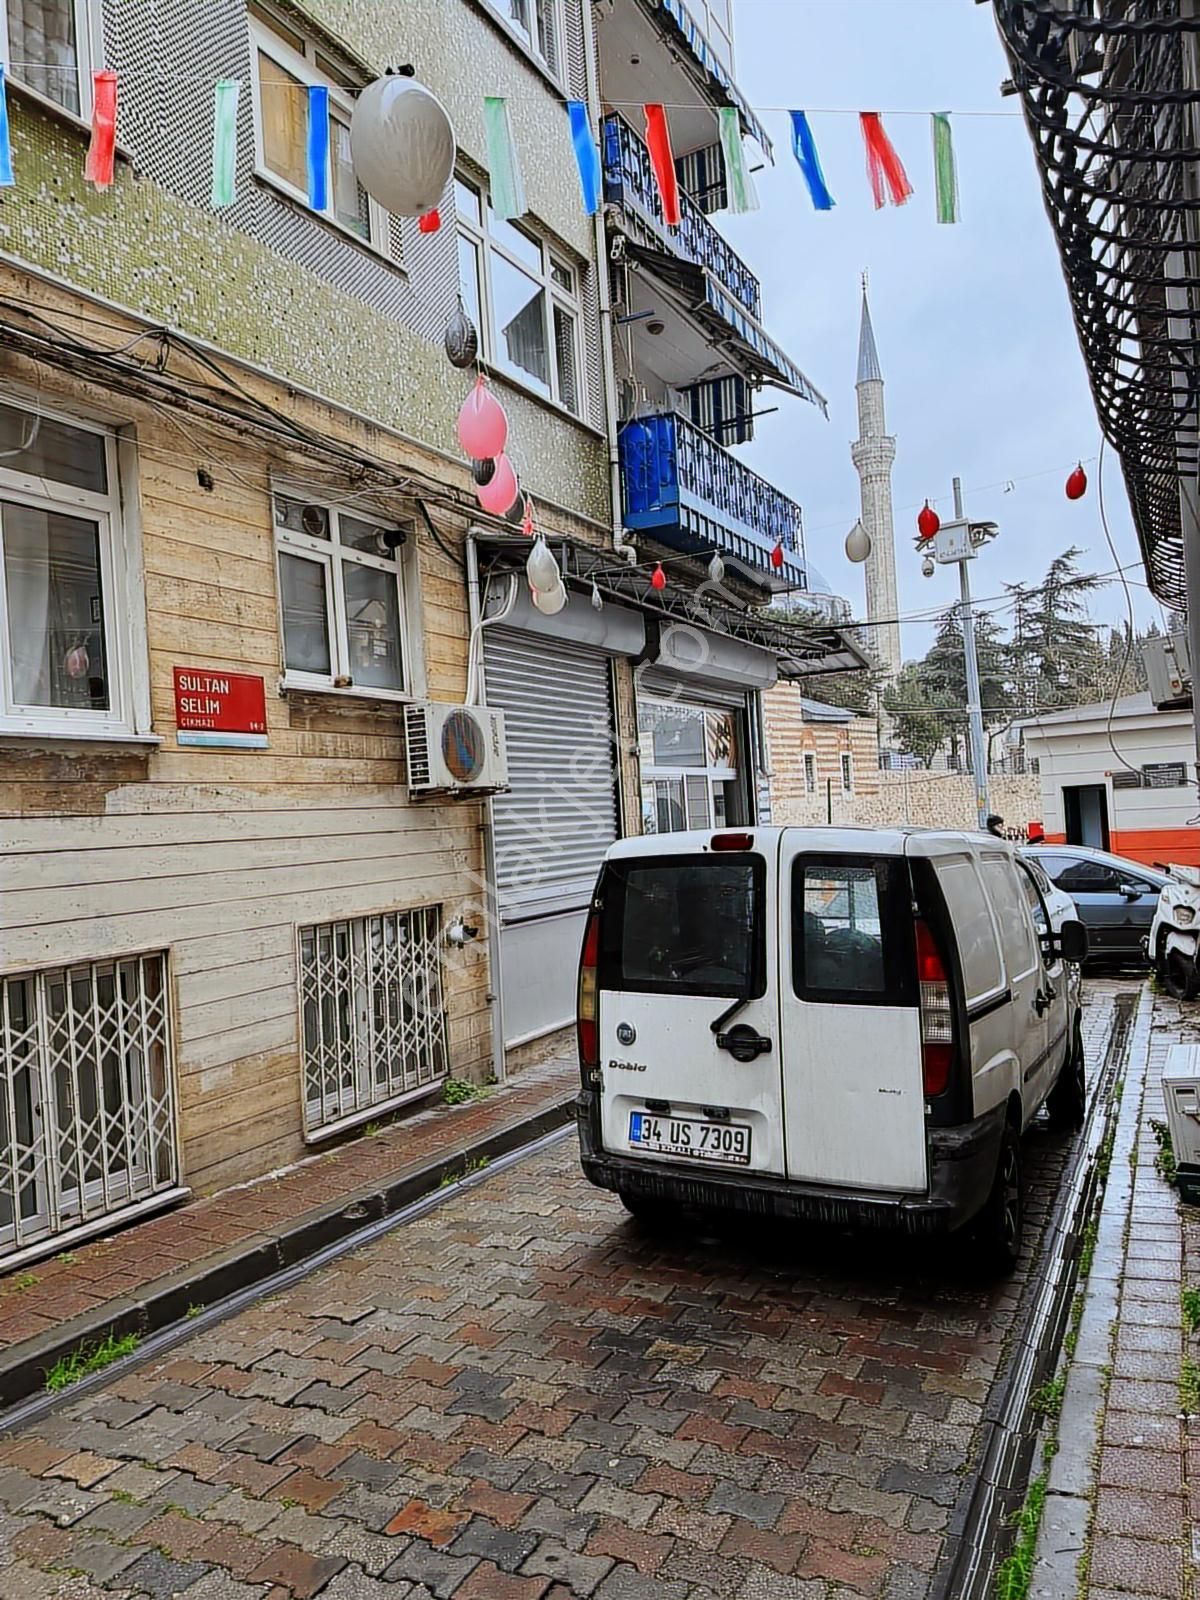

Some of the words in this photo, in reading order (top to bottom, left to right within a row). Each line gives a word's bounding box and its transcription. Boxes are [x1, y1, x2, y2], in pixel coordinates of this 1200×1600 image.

[179, 675, 230, 695] SULTAN
[180, 696, 221, 715] SELİM
[642, 1118, 662, 1142] 34
[670, 1122, 691, 1146] US
[699, 1126, 745, 1153] 7309
